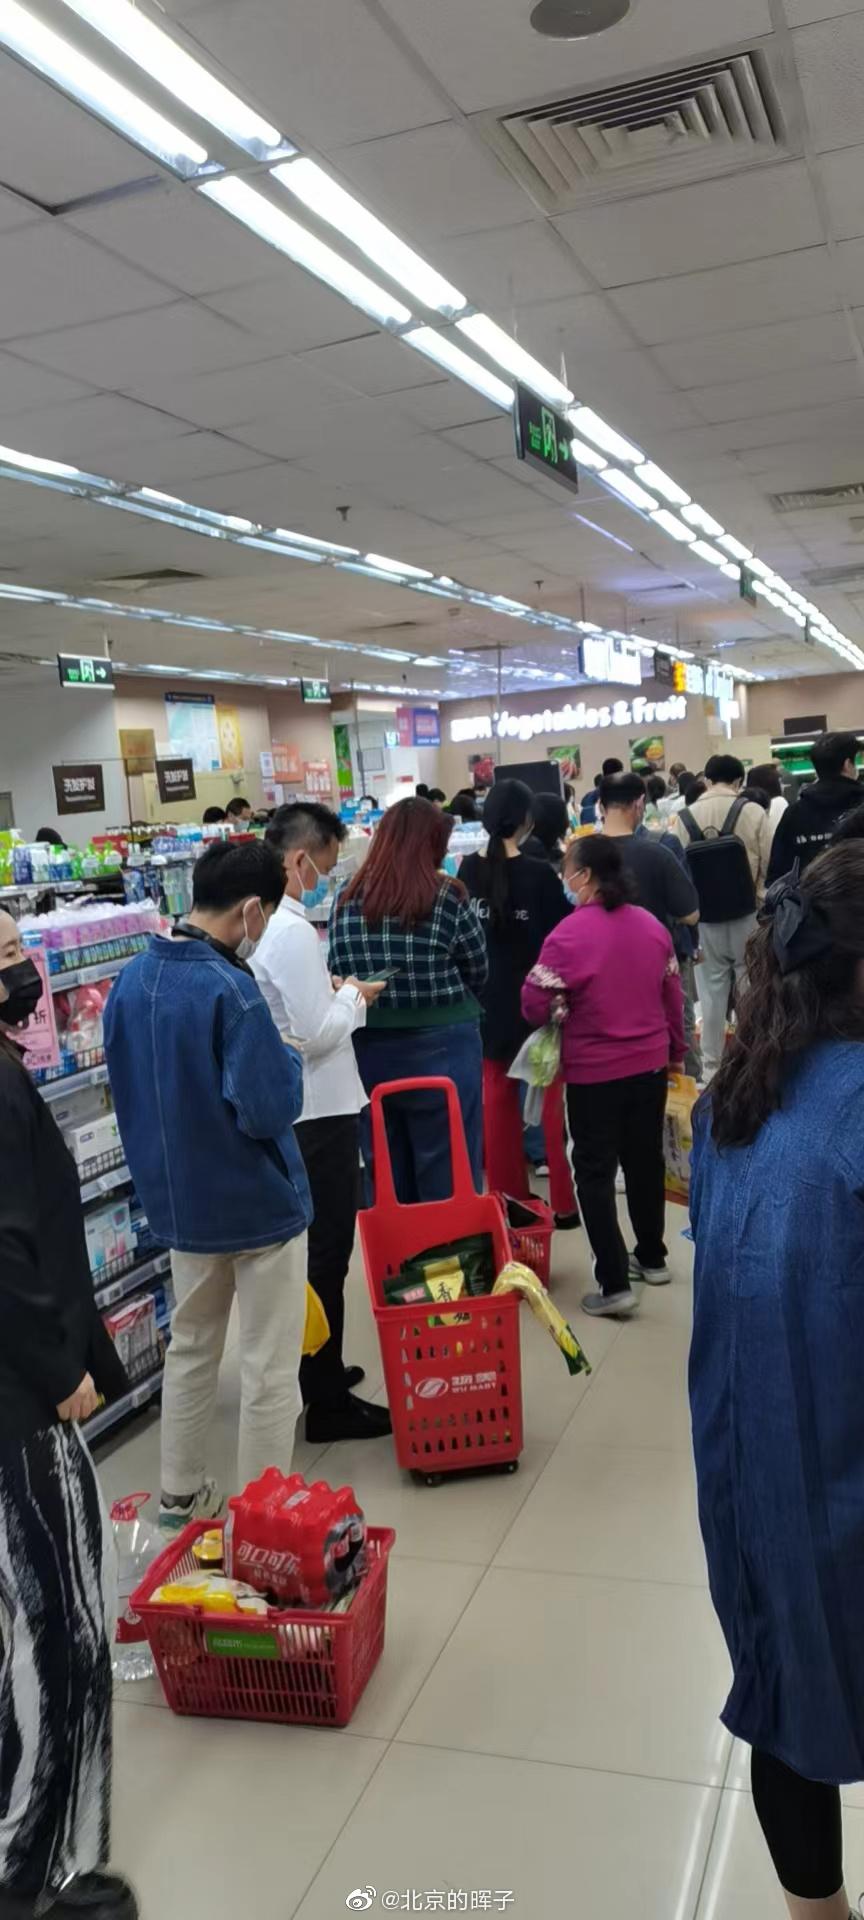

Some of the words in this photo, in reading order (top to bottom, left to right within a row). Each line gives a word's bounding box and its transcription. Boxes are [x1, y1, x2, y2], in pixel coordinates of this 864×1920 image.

[613, 700, 632, 725] &
[632, 695, 688, 723] Fruit
[237, 1541, 302, 1576] 可口可乐
